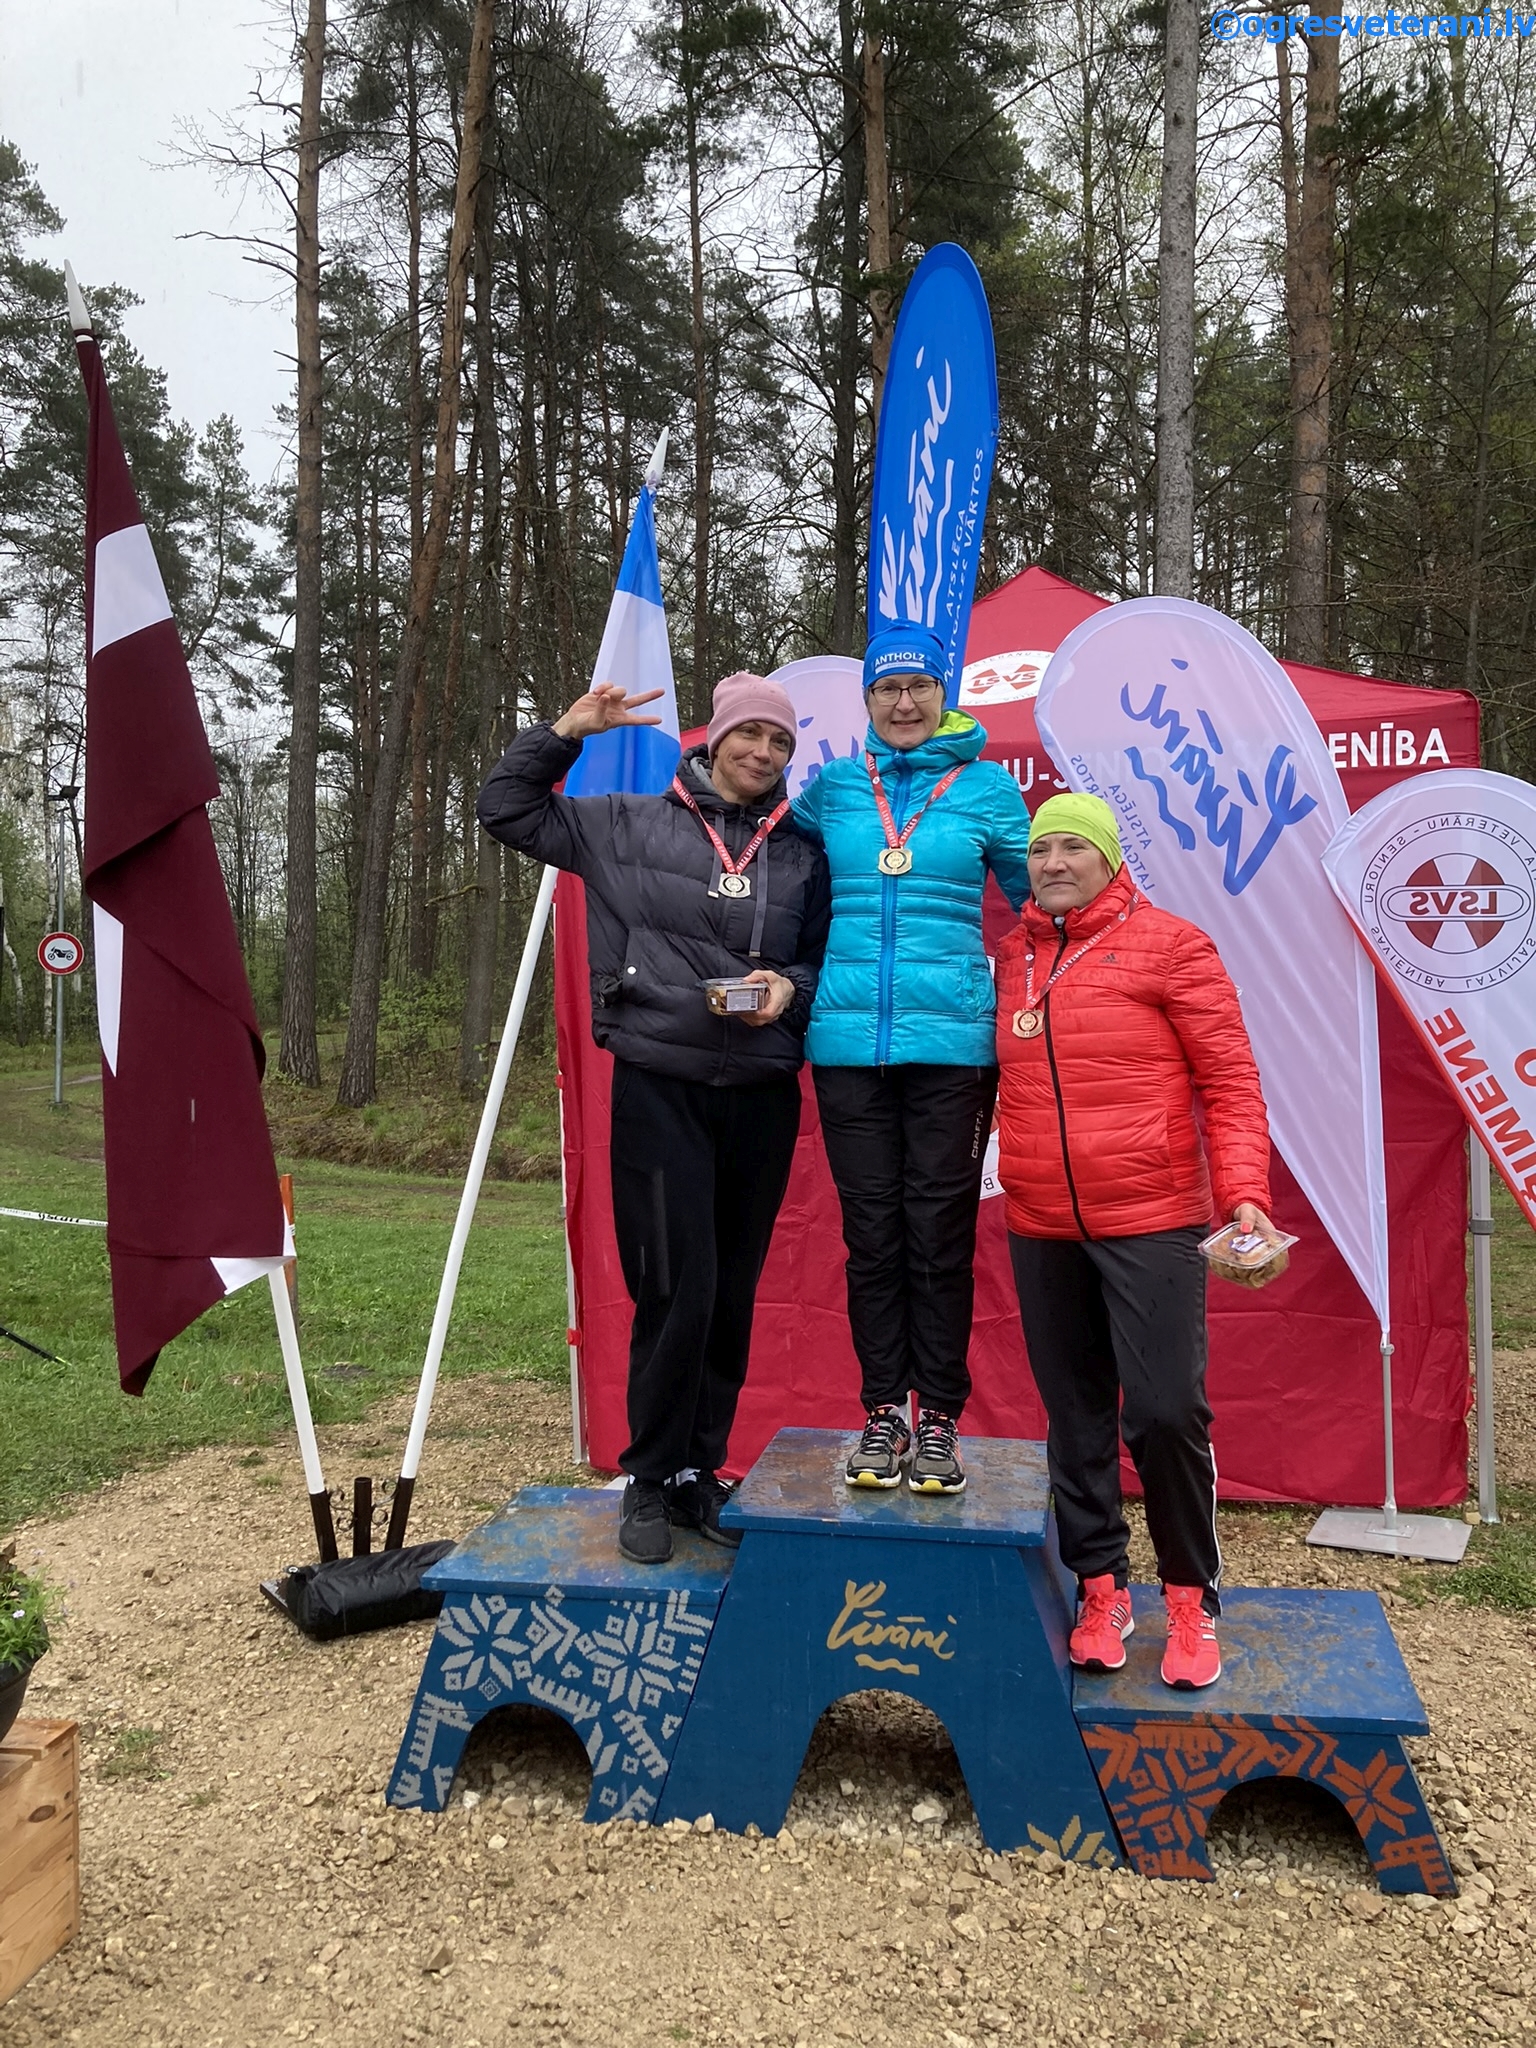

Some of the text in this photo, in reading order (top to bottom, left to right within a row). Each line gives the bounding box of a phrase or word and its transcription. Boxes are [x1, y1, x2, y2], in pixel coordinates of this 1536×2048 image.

[964, 447, 985, 550] VĀRTOS
[874, 651, 926, 668] ANTHOLZ
[972, 672, 1037, 687] LSVS
[1327, 722, 1451, 769] ENĪBA
[971, 1117, 983, 1159] CRAFT
